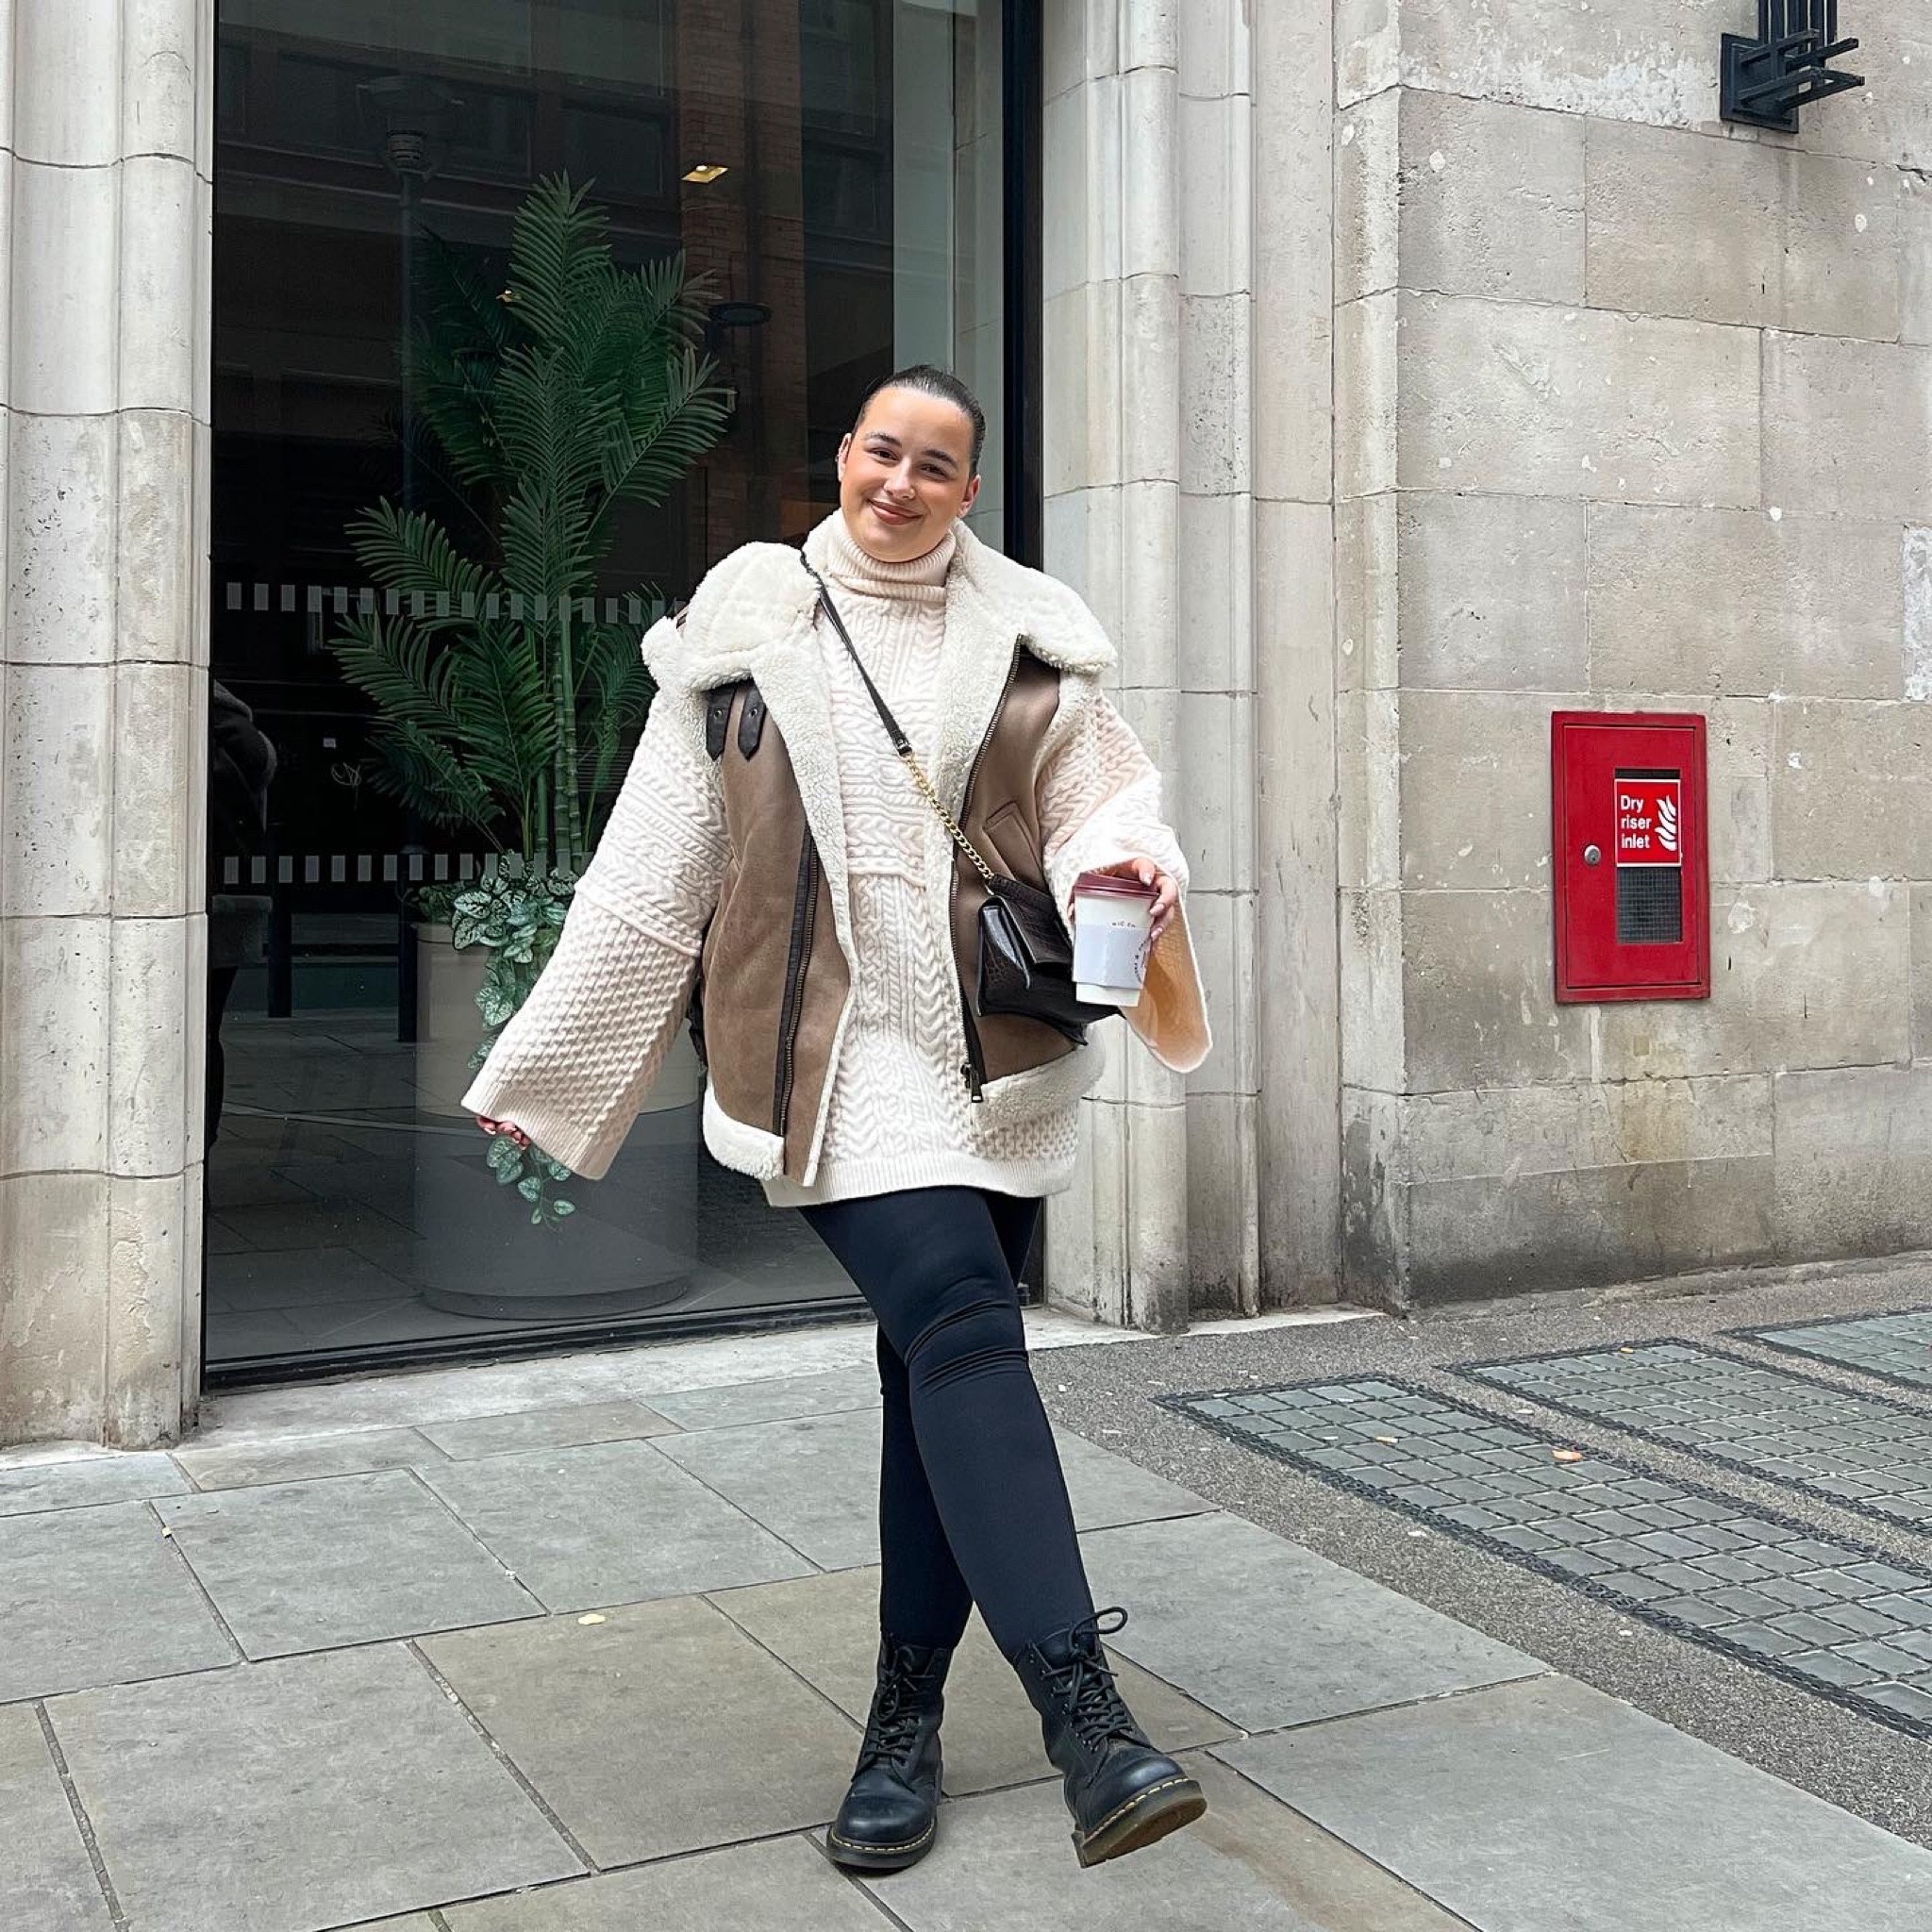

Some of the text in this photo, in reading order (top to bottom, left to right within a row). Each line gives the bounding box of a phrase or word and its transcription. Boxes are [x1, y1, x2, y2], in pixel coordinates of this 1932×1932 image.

[1621, 794, 1643, 813] Dry
[1621, 814, 1652, 829] riser
[1622, 833, 1650, 849] inlet
